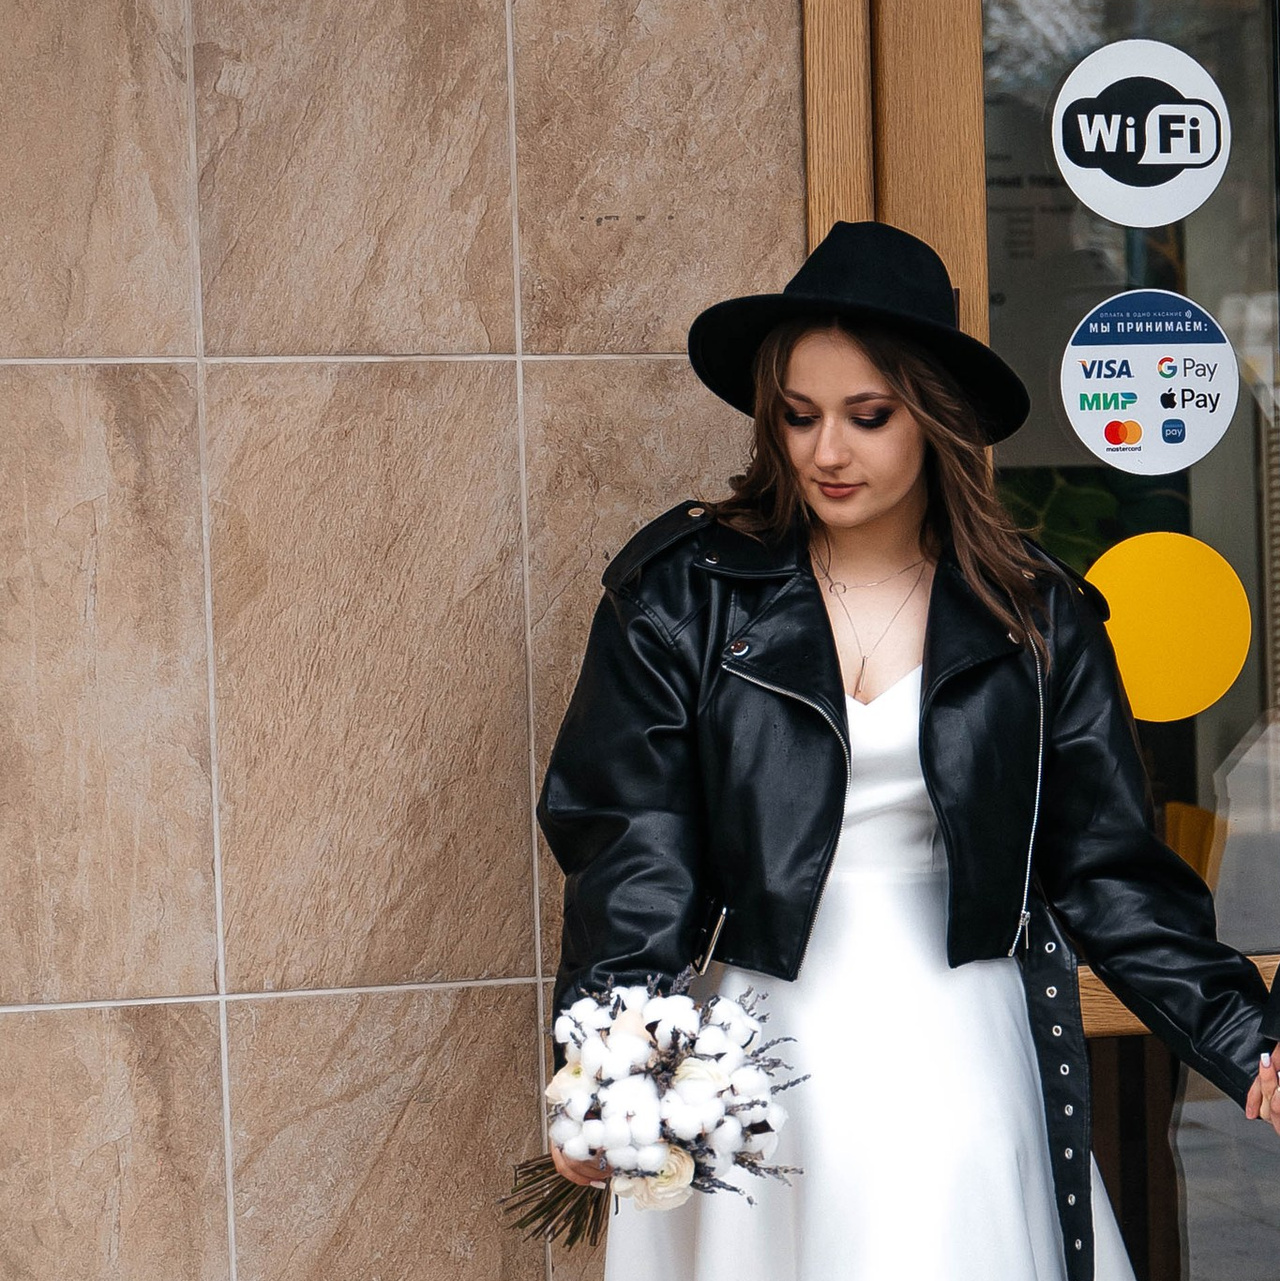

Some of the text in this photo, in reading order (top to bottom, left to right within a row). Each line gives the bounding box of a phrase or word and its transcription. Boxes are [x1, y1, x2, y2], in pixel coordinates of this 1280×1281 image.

[1089, 321, 1208, 333] МЫ ПРИНИМАЕМ:
[1077, 359, 1135, 379] VISA
[1183, 357, 1218, 382] Pay
[1080, 392, 1138, 411] МИР
[1181, 388, 1220, 413] Pay
[1165, 427, 1183, 437] pay
